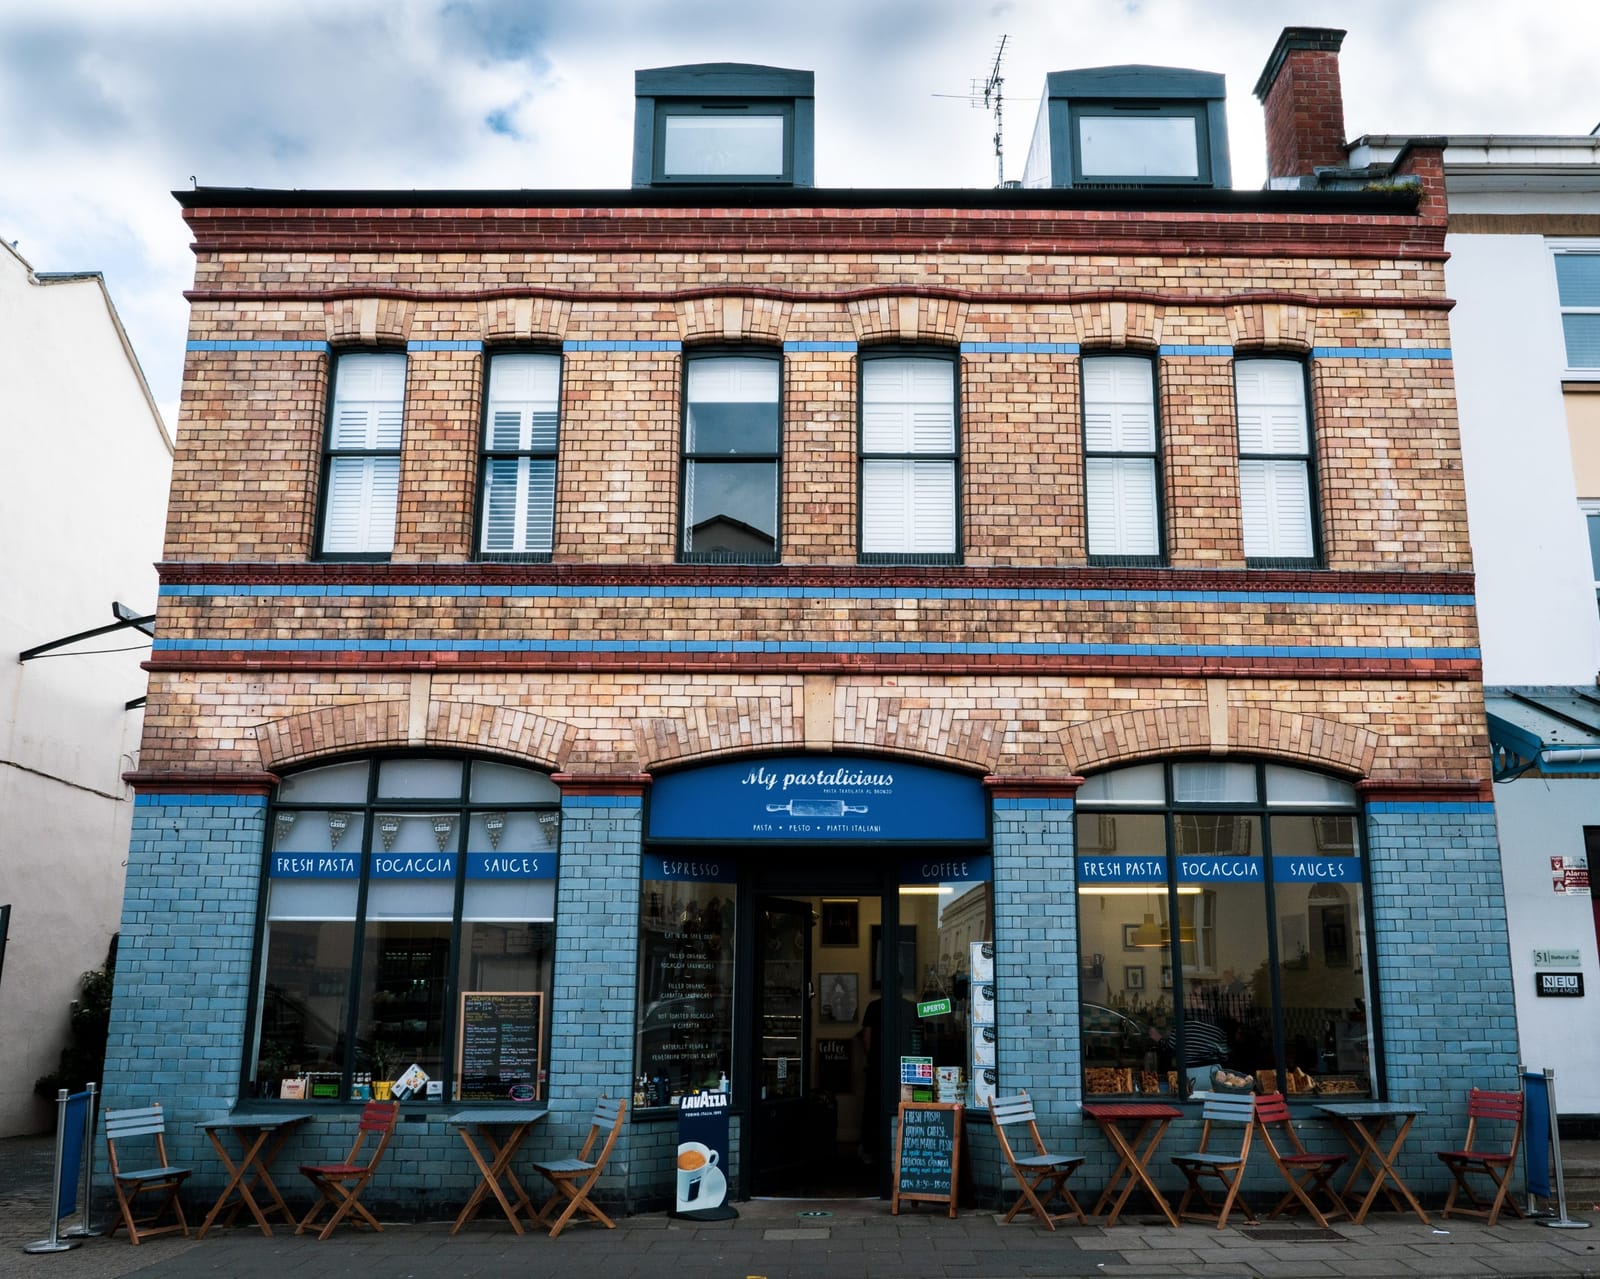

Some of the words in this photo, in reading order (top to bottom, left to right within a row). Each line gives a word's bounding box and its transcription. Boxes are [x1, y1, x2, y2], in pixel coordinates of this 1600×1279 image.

[742, 767, 778, 790] My
[783, 768, 893, 790] pastalicious
[752, 824, 773, 832] PASTA
[788, 824, 811, 832] PESTO
[826, 824, 849, 832] PIATTI
[851, 824, 881, 833] ITALIANI
[277, 857, 313, 873] FRESH
[318, 857, 355, 873] PASTA
[376, 857, 451, 873] FOCACCIA
[484, 857, 539, 873] SAUCES
[662, 860, 720, 877] ESPRESSO
[921, 861, 969, 878] COFFEE
[1083, 861, 1121, 877] FRESH
[1125, 861, 1162, 877] PASTA
[1182, 861, 1258, 877] FOCACCIA
[1290, 862, 1345, 877] SAUCES
[1536, 952, 1547, 962] 51
[1544, 976, 1576, 987] NEU
[923, 1003, 946, 1014] APERTO
[681, 1091, 727, 1109] LAVAZZA
[905, 1111, 922, 1124] FRESH
